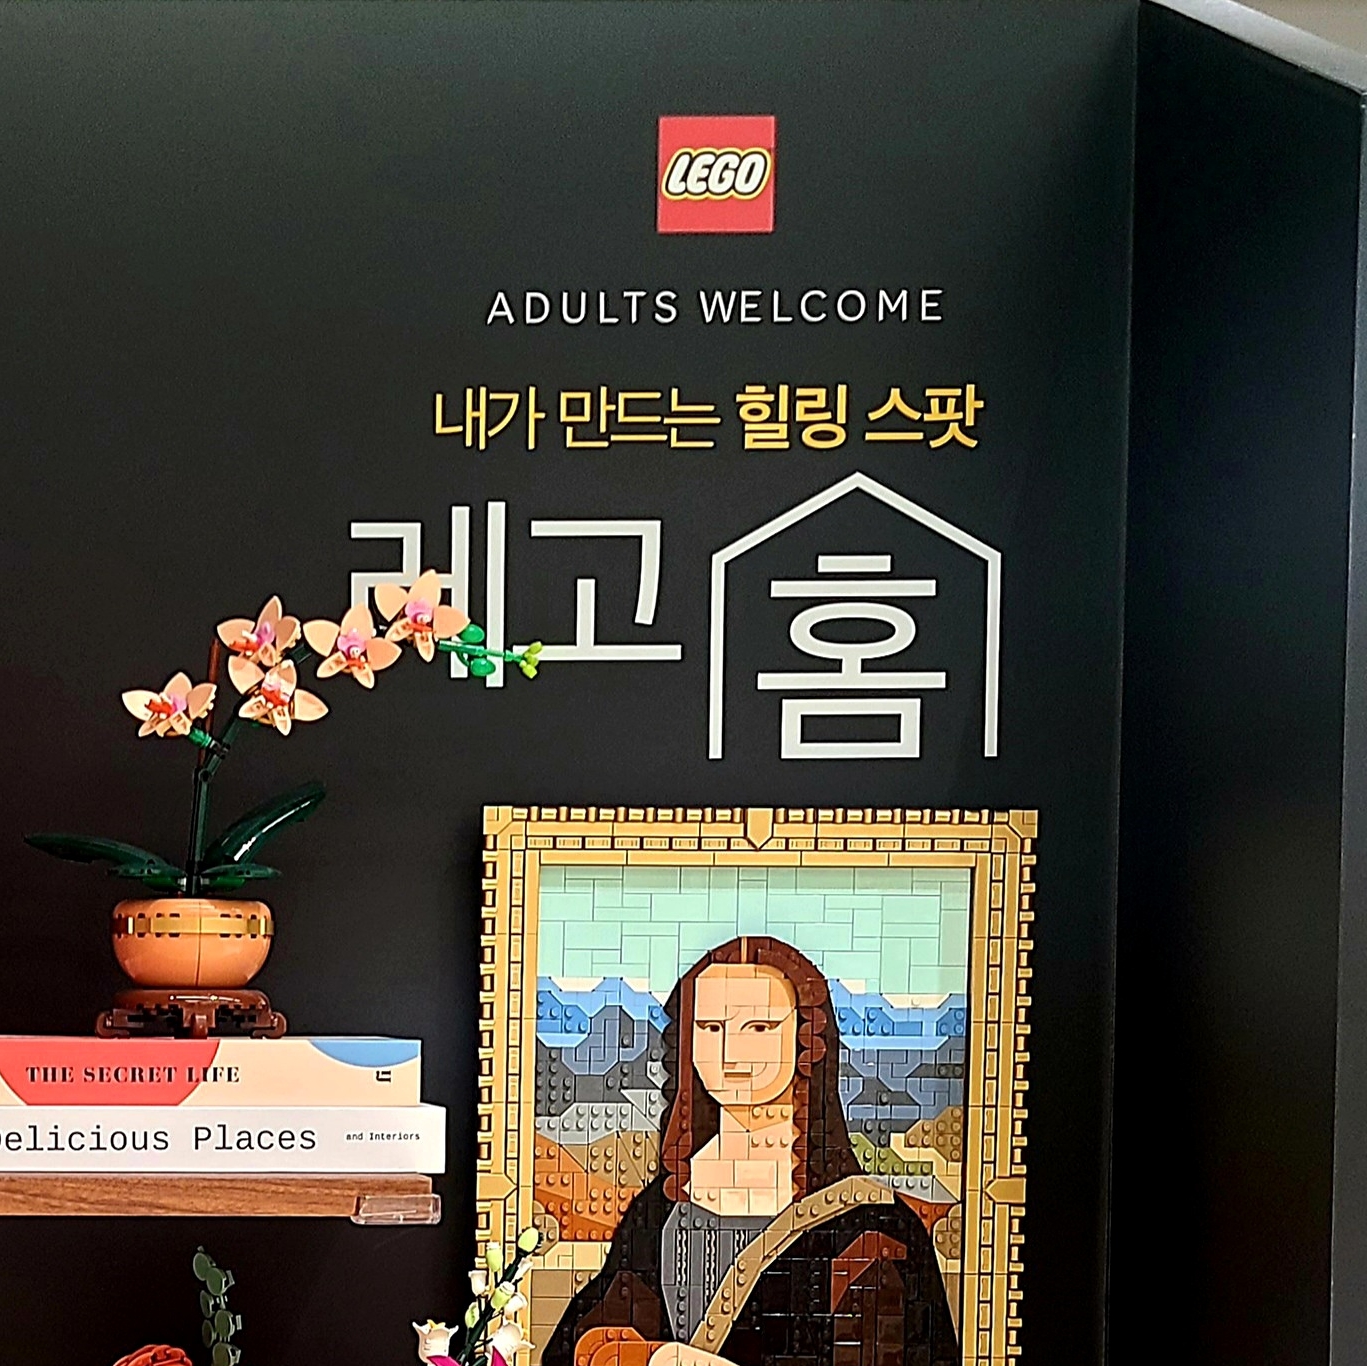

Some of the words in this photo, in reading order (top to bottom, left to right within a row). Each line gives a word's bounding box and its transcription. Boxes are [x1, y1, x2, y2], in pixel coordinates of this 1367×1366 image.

[664, 151, 770, 196] LEGO
[487, 291, 678, 325] ADULTS
[699, 290, 944, 324] WELCOME
[435, 386, 546, 451] 내가
[559, 386, 721, 448] 만드는
[736, 383, 847, 450] 힐링
[865, 383, 984, 448] 스팟
[351, 501, 681, 687] 레고
[757, 555, 945, 758] 홈
[26, 1067, 74, 1082] THE
[84, 1067, 177, 1083] SECRET
[187, 1067, 239, 1082] LIFE
[193, 1125, 316, 1150] Places
[346, 1132, 363, 1141] and
[369, 1132, 420, 1141] Interiors
